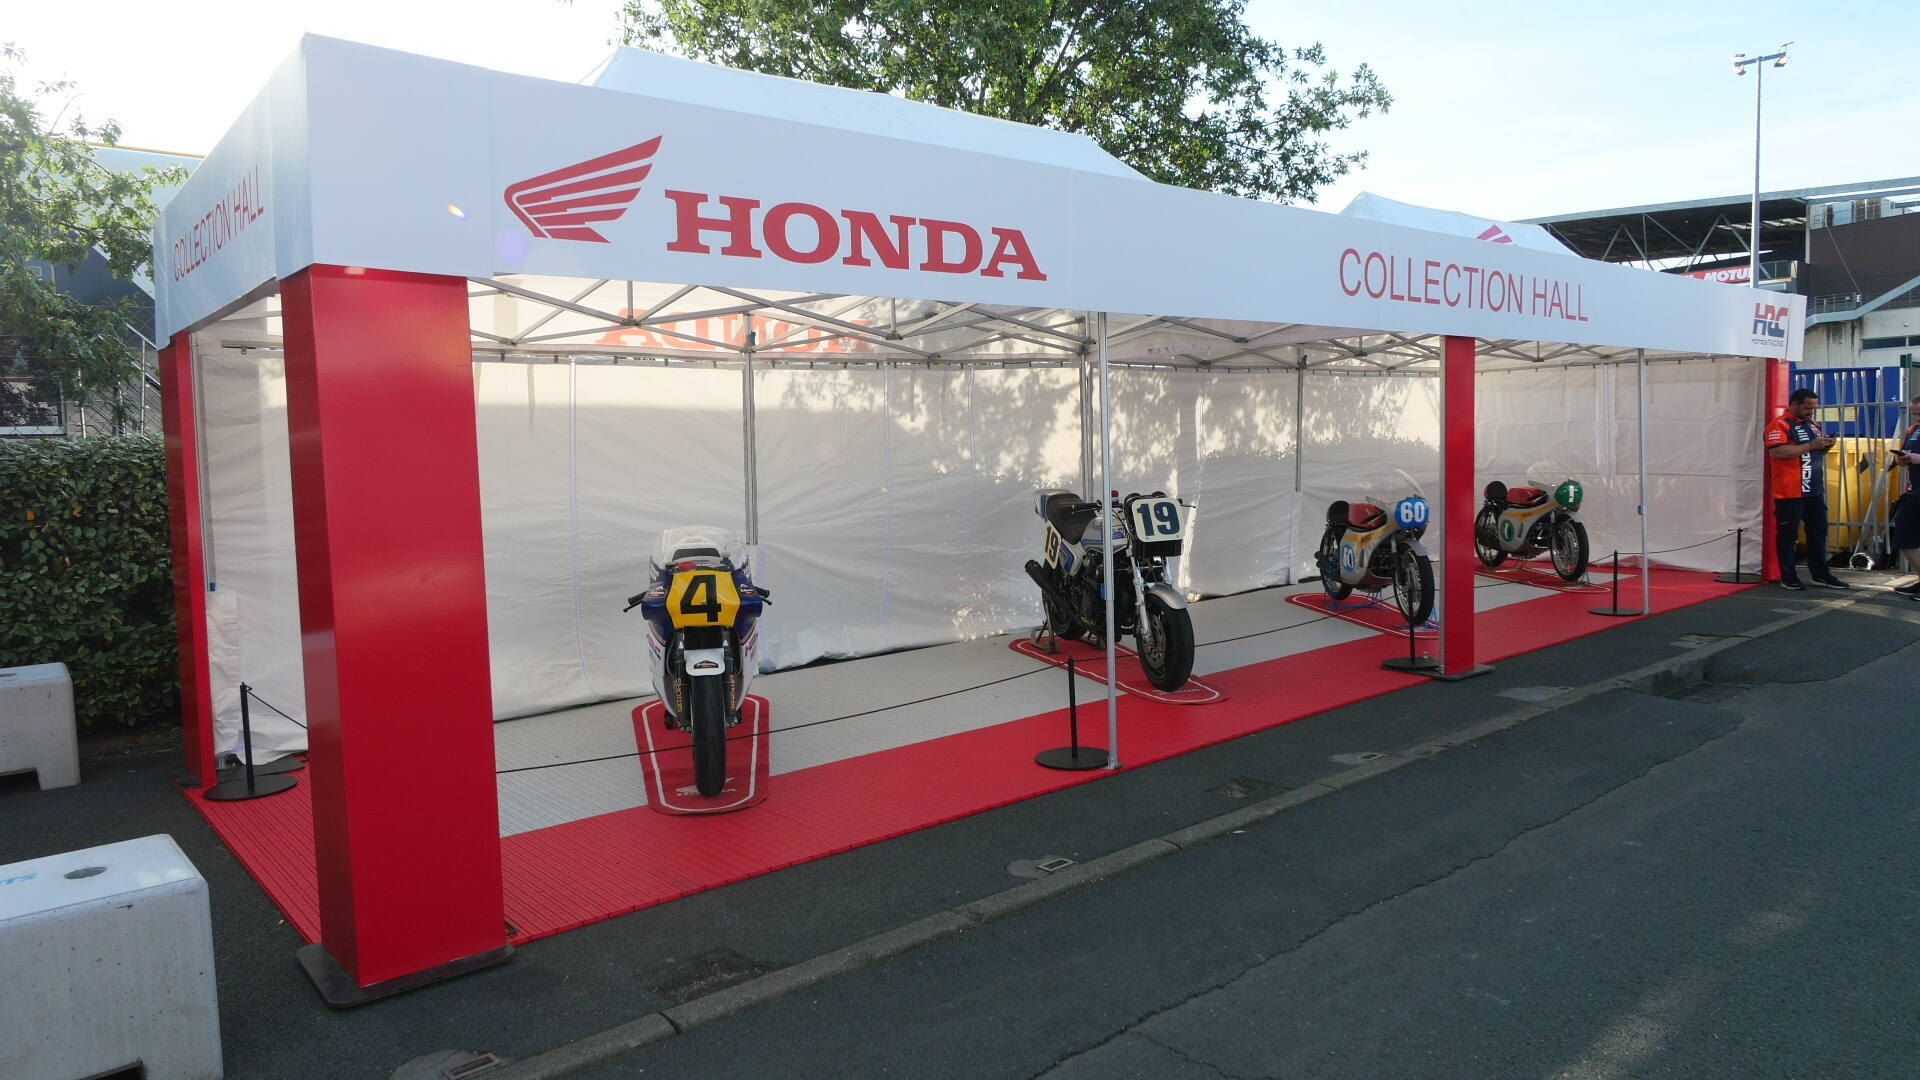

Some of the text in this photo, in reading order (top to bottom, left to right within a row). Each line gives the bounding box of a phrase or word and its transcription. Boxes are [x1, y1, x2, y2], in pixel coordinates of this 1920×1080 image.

[173, 163, 264, 281] COLLECTION HALL
[665, 189, 1047, 281] HONDA
[1339, 248, 1588, 322] COLLECTION HALL
[1137, 501, 1180, 537] 19
[1400, 501, 1426, 523] 60
[1044, 526, 1059, 562] 19
[1343, 547, 1354, 569] 60
[680, 574, 721, 622] 4
